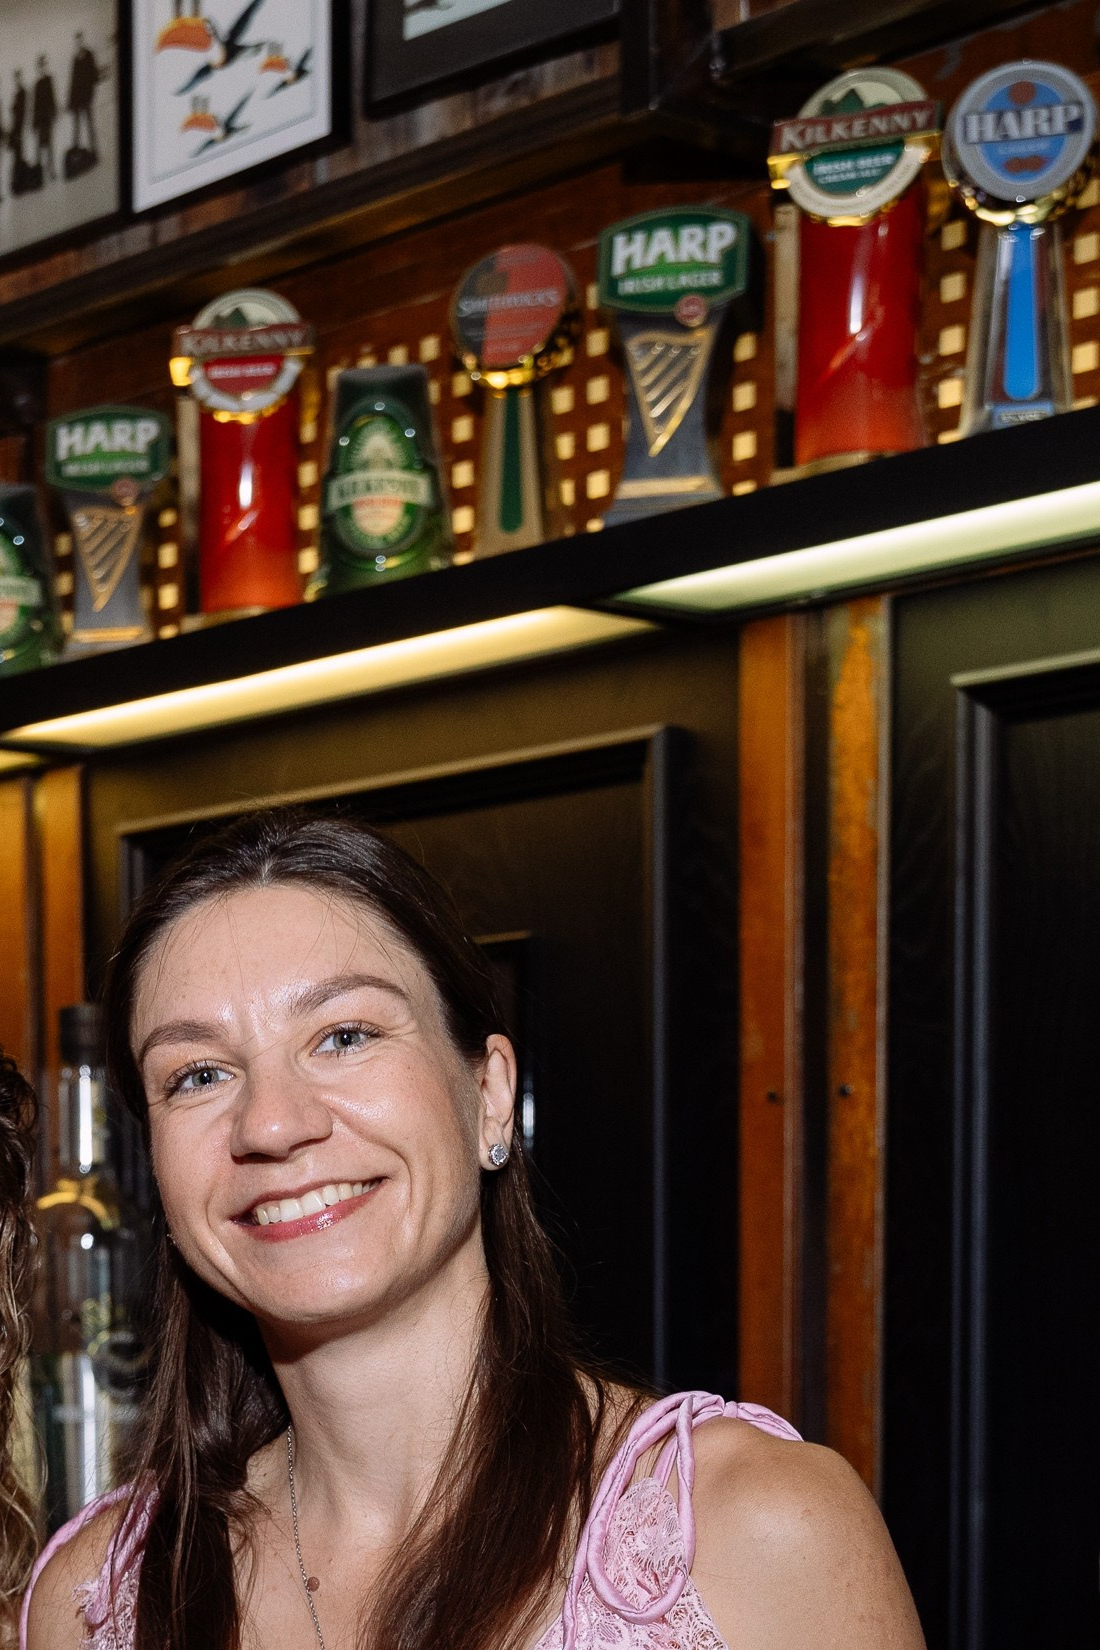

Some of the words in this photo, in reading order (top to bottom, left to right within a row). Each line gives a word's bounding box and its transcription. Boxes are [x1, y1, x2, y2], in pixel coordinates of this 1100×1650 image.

[780, 109, 932, 152] KILKENNY
[964, 104, 1082, 142] HARP
[612, 221, 737, 279] HARP
[56, 419, 159, 461] HARP
